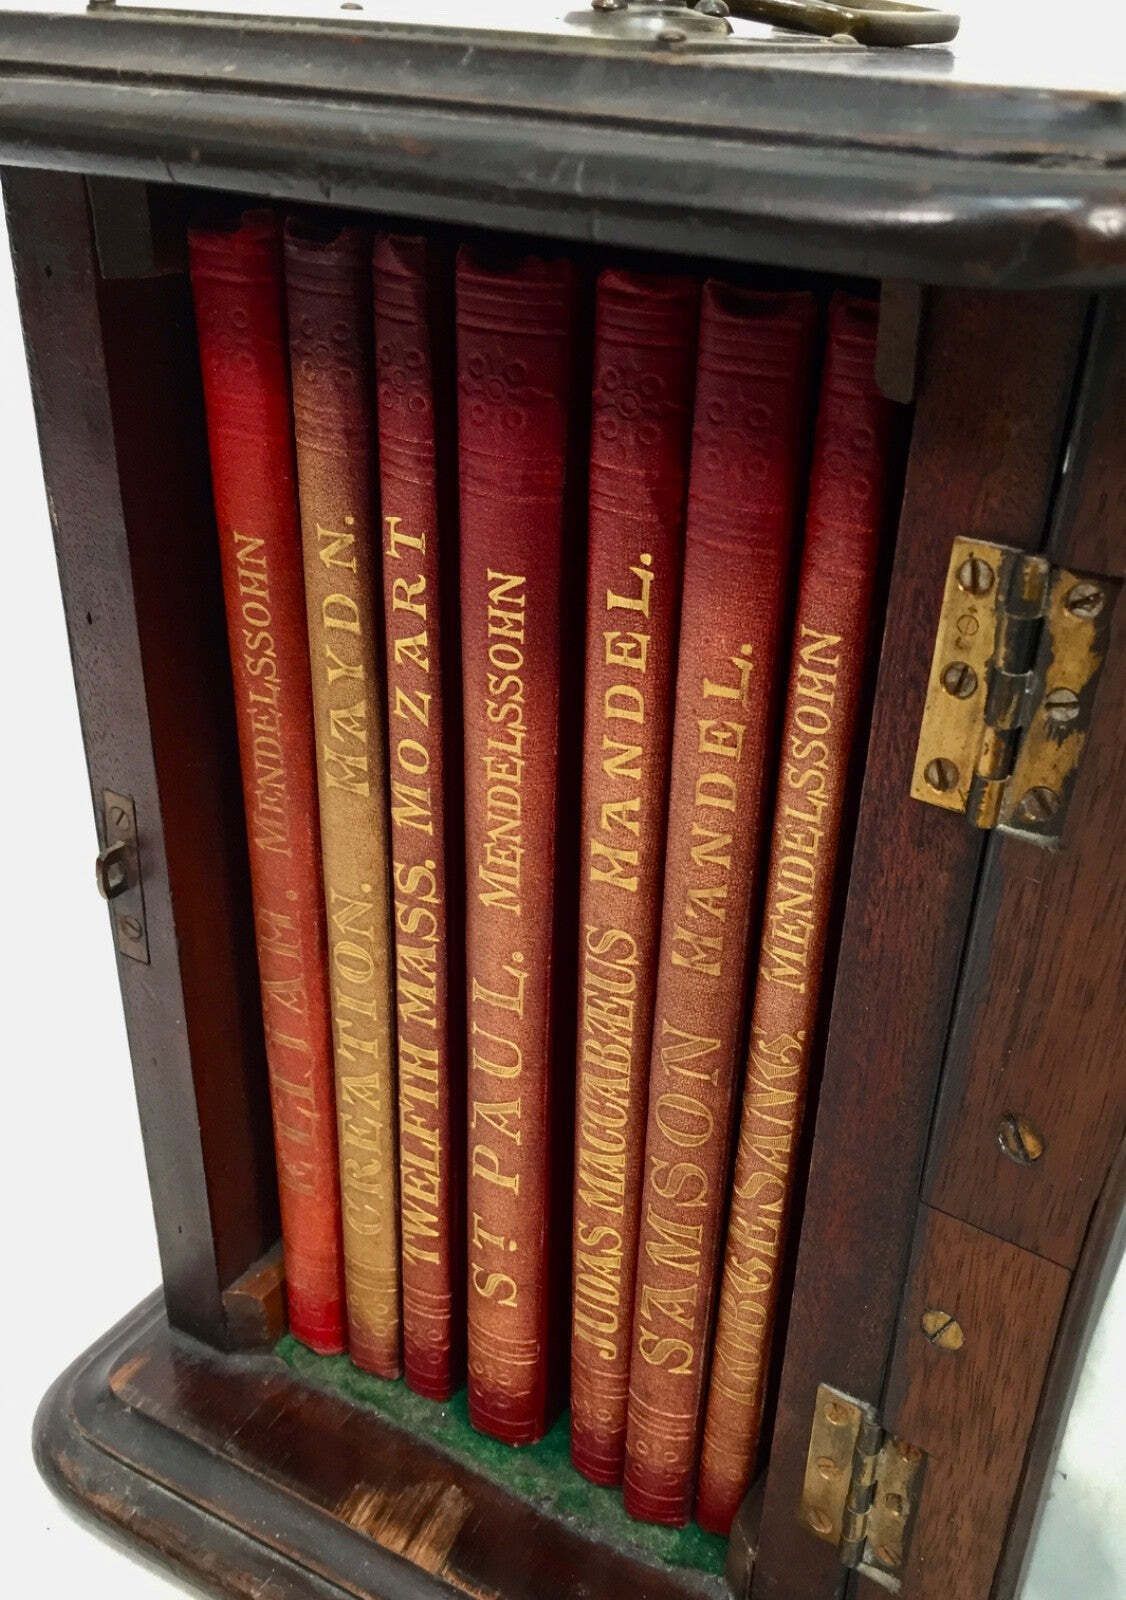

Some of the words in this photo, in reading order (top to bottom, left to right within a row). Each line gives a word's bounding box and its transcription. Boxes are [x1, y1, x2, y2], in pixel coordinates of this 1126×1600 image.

[233, 531, 292, 857] MENDELSSOHN
[316, 515, 370, 798] HAYDN.
[385, 516, 433, 836] MOZART
[479, 568, 527, 914] MENDELSSOHN
[590, 552, 654, 893] HANDEL.
[671, 643, 753, 977] HANDEL.
[761, 623, 842, 993] MENDELSSOHN
[331, 883, 383, 1236] CREATION.
[394, 859, 440, 1028] MASS.
[471, 951, 529, 1195] PAUL.
[399, 1034, 441, 1265] TWELFTH
[574, 1222, 625, 1360] JUDAS
[638, 1019, 721, 1376] SAMSON
